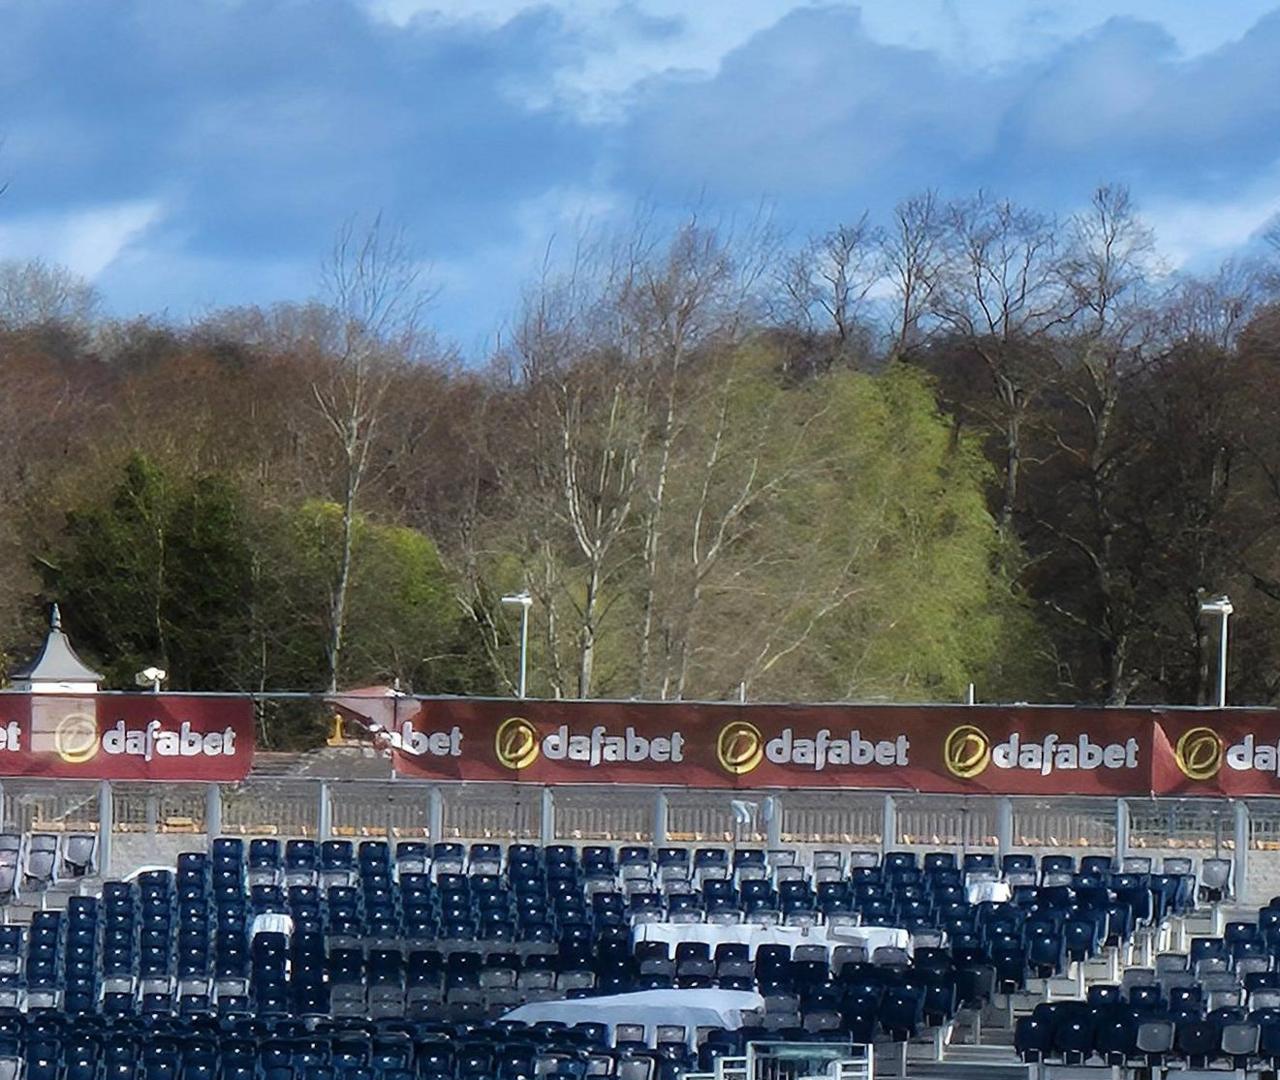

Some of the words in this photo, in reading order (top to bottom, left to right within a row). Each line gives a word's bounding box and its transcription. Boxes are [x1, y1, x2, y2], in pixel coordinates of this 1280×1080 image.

[102, 720, 236, 761] dafabet
[543, 725, 684, 766] dafabet
[766, 729, 909, 770] dafabet
[991, 733, 1139, 776] dafabet
